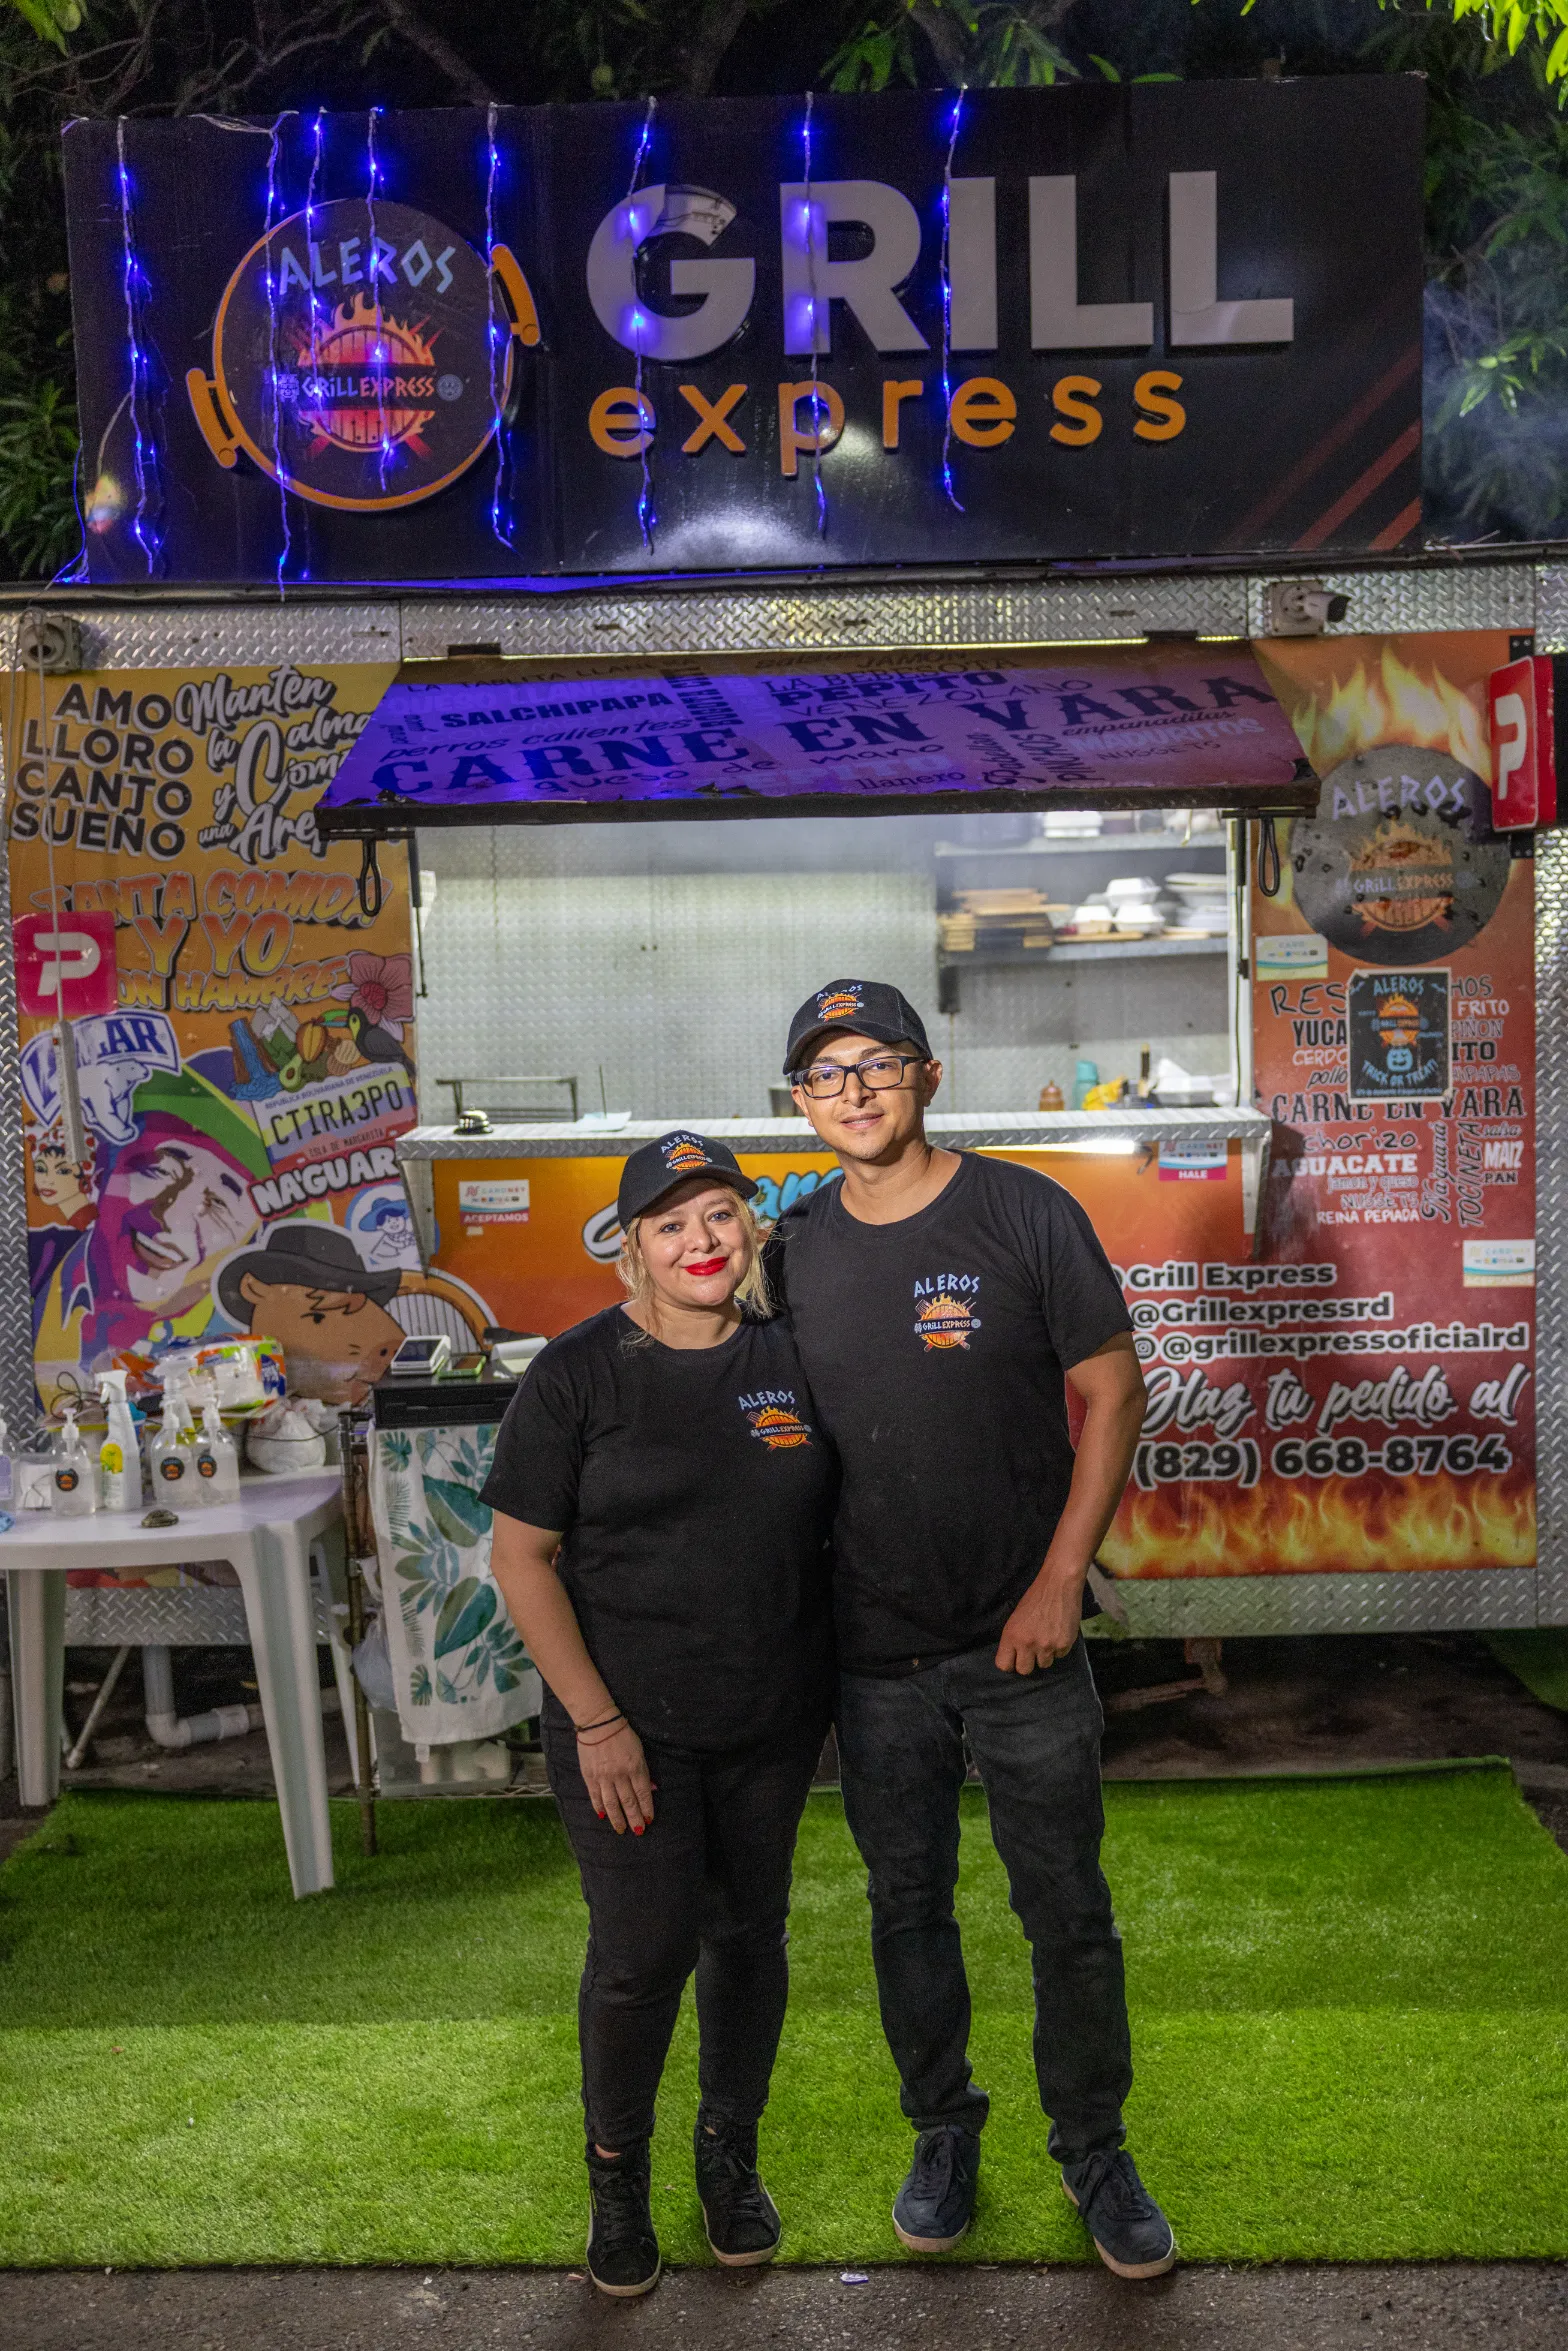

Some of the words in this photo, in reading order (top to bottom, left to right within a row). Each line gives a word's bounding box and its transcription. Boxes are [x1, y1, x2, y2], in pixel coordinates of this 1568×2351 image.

[277, 237, 456, 295] ALEROS
[586, 170, 1294, 362] GRILL
[589, 370, 1186, 479] express
[762, 677, 815, 693] LA
[772, 671, 1008, 707] PEPITO
[785, 679, 1093, 717] VENEZOLANO
[53, 683, 172, 732] AMO
[441, 692, 674, 728] SALCHIPAPA
[1062, 709, 1237, 736] empanaditas
[24, 719, 194, 776] LLORO
[207, 728, 237, 771] la
[370, 728, 750, 794] CARNE
[774, 711, 938, 753] EN
[956, 676, 1279, 731] VARA
[380, 738, 512, 763] perros
[522, 717, 694, 746] calientes
[535, 769, 690, 793] queso
[722, 760, 778, 773] de
[810, 744, 946, 764] mano
[854, 771, 966, 790] llanero
[16, 761, 192, 819] CANTO
[213, 784, 236, 822] y
[1332, 774, 1466, 821] ALEROS
[199, 823, 235, 845] una
[31, 872, 196, 921] TANTA
[204, 869, 393, 927] COMIDA
[134, 915, 188, 978] Y
[201, 910, 294, 978] YO
[1373, 975, 1425, 997] ALEROS
[1457, 999, 1510, 1017] FRITO
[1292, 1019, 1347, 1047] YUCA
[1305, 1066, 1348, 1091] pollo
[1271, 1093, 1373, 1124] CARNE
[1440, 1086, 1526, 1119] VARA
[1303, 1127, 1418, 1153] chorizo
[1482, 1124, 1522, 1138] salsa
[1178, 1169, 1208, 1179] HALE
[1272, 1153, 1418, 1177] AGUACATE
[1456, 1120, 1484, 1229] TOCINETA
[1483, 1170, 1518, 1185] PAN
[463, 1212, 529, 1223] ACEPTAMOS
[1316, 1211, 1360, 1225] REINA
[1363, 1209, 1420, 1224] PEPIADA
[914, 1273, 980, 1298] ALEROS
[1130, 1263, 1195, 1290] Grill
[1206, 1263, 1334, 1293] Express
[1131, 1295, 1392, 1329] @Grillexpressrd
[1162, 1324, 1527, 1362] @grillexpressoficialrd
[738, 1390, 796, 1411] ALEROS
[1142, 1365, 1256, 1437] Haz
[1469, 1363, 1531, 1427] al
[1134, 1440, 1260, 1489] (829)
[1272, 1434, 1512, 1475] 668-8764
